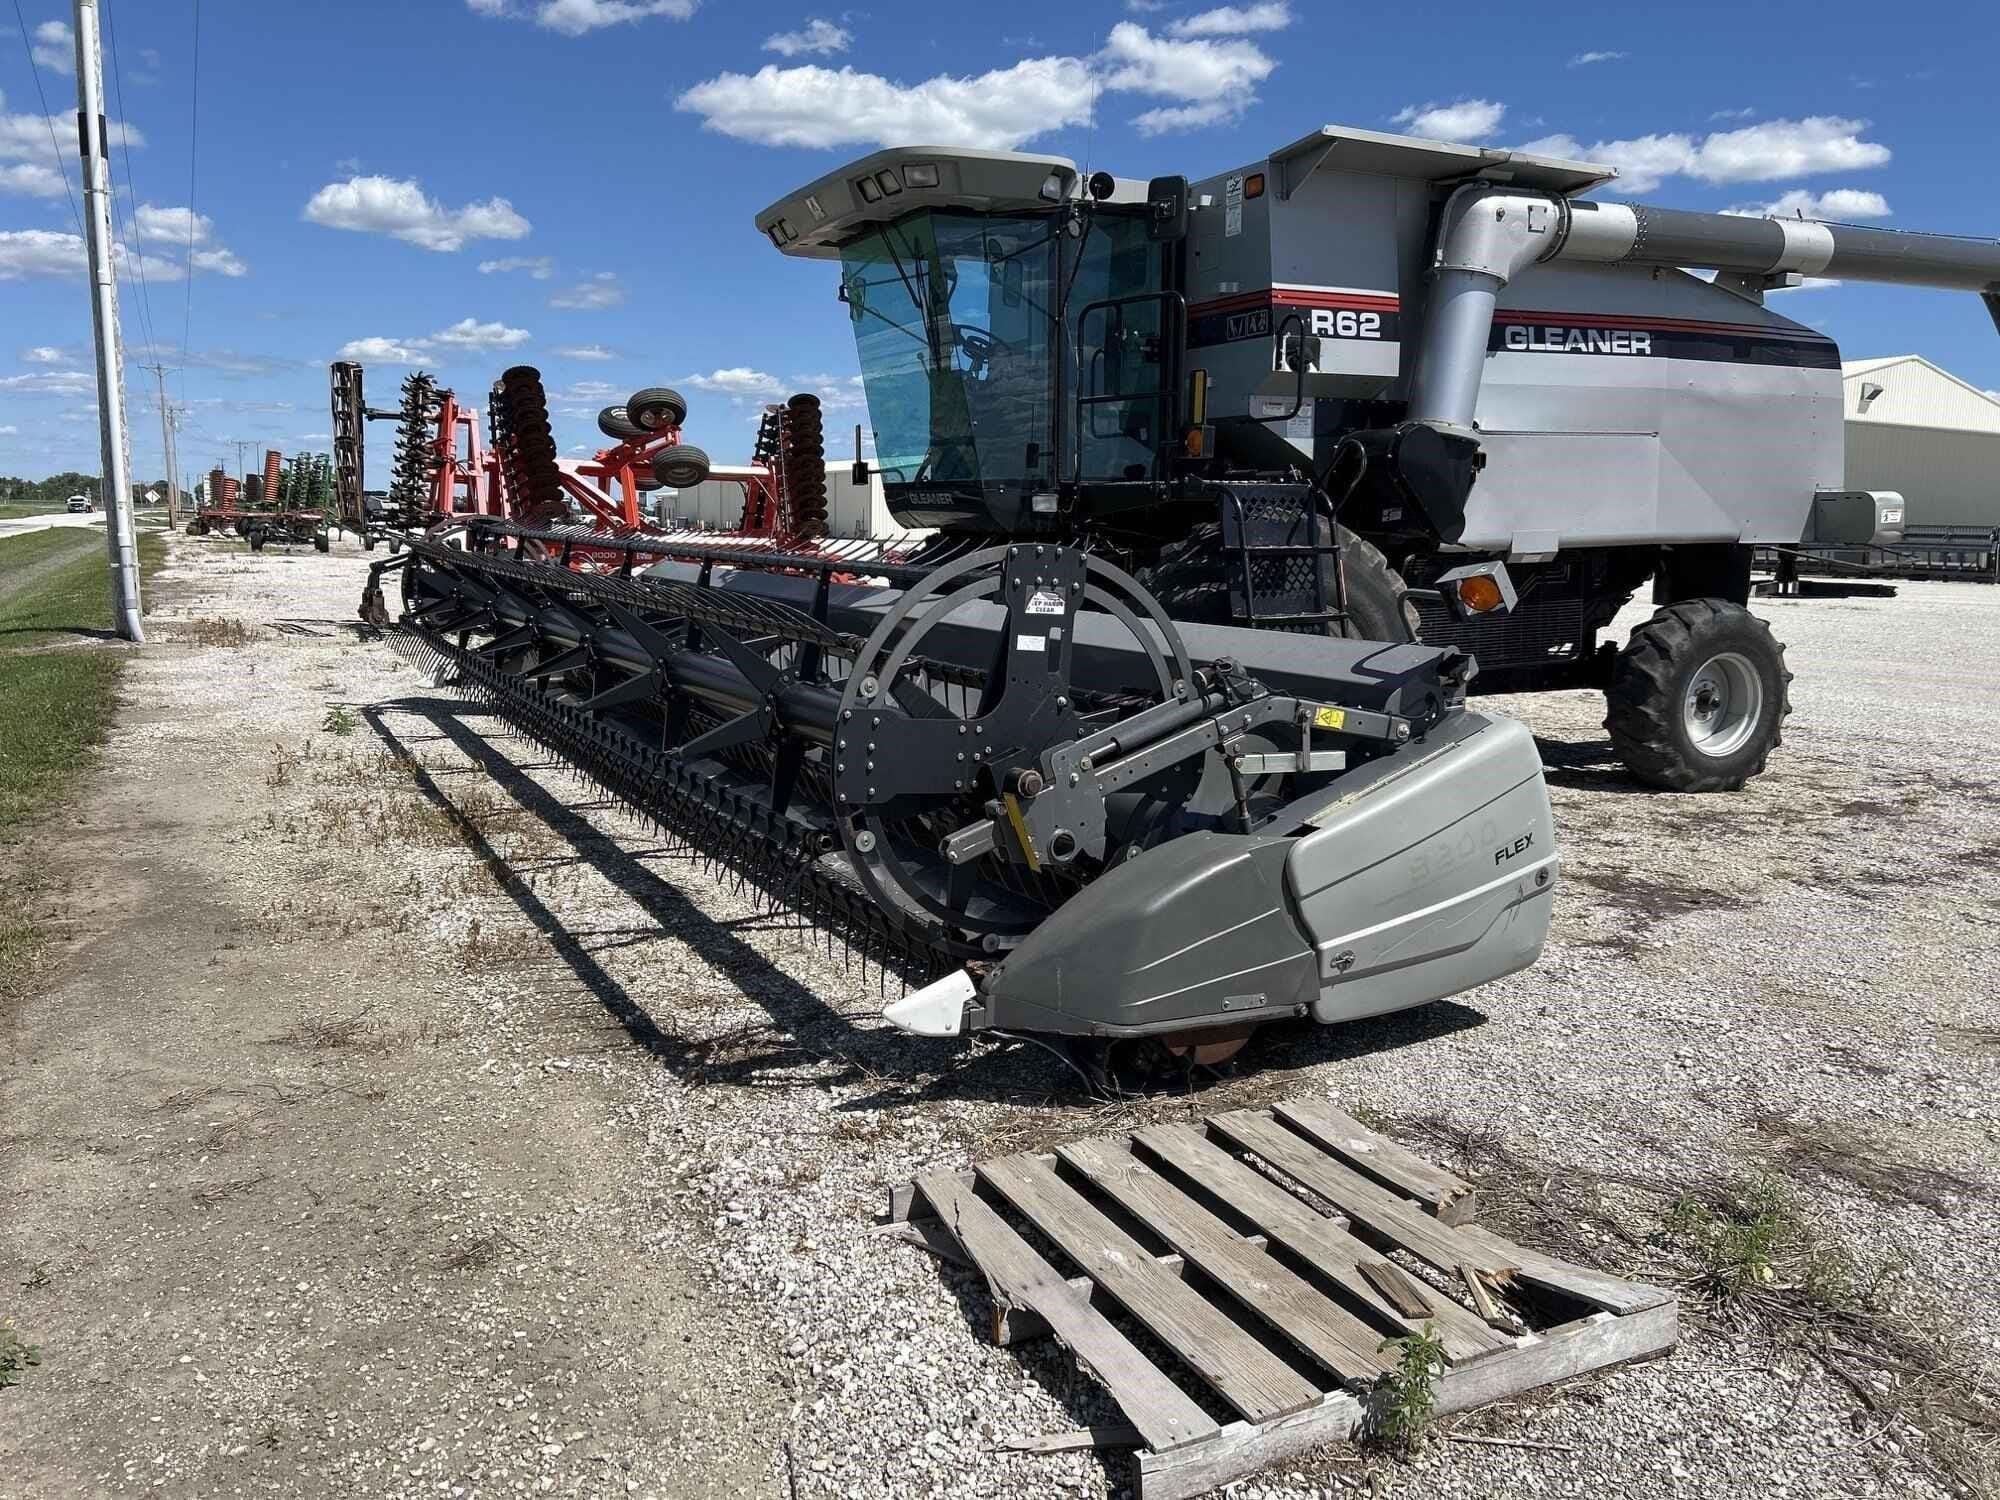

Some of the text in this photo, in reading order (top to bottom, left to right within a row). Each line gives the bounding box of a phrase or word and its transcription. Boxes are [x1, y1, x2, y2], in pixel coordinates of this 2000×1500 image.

[1311, 309, 1381, 338] R62
[1504, 325, 1652, 355] GLEANER
[910, 493, 954, 505] GLEANER
[1494, 832, 1535, 865] FLEX
